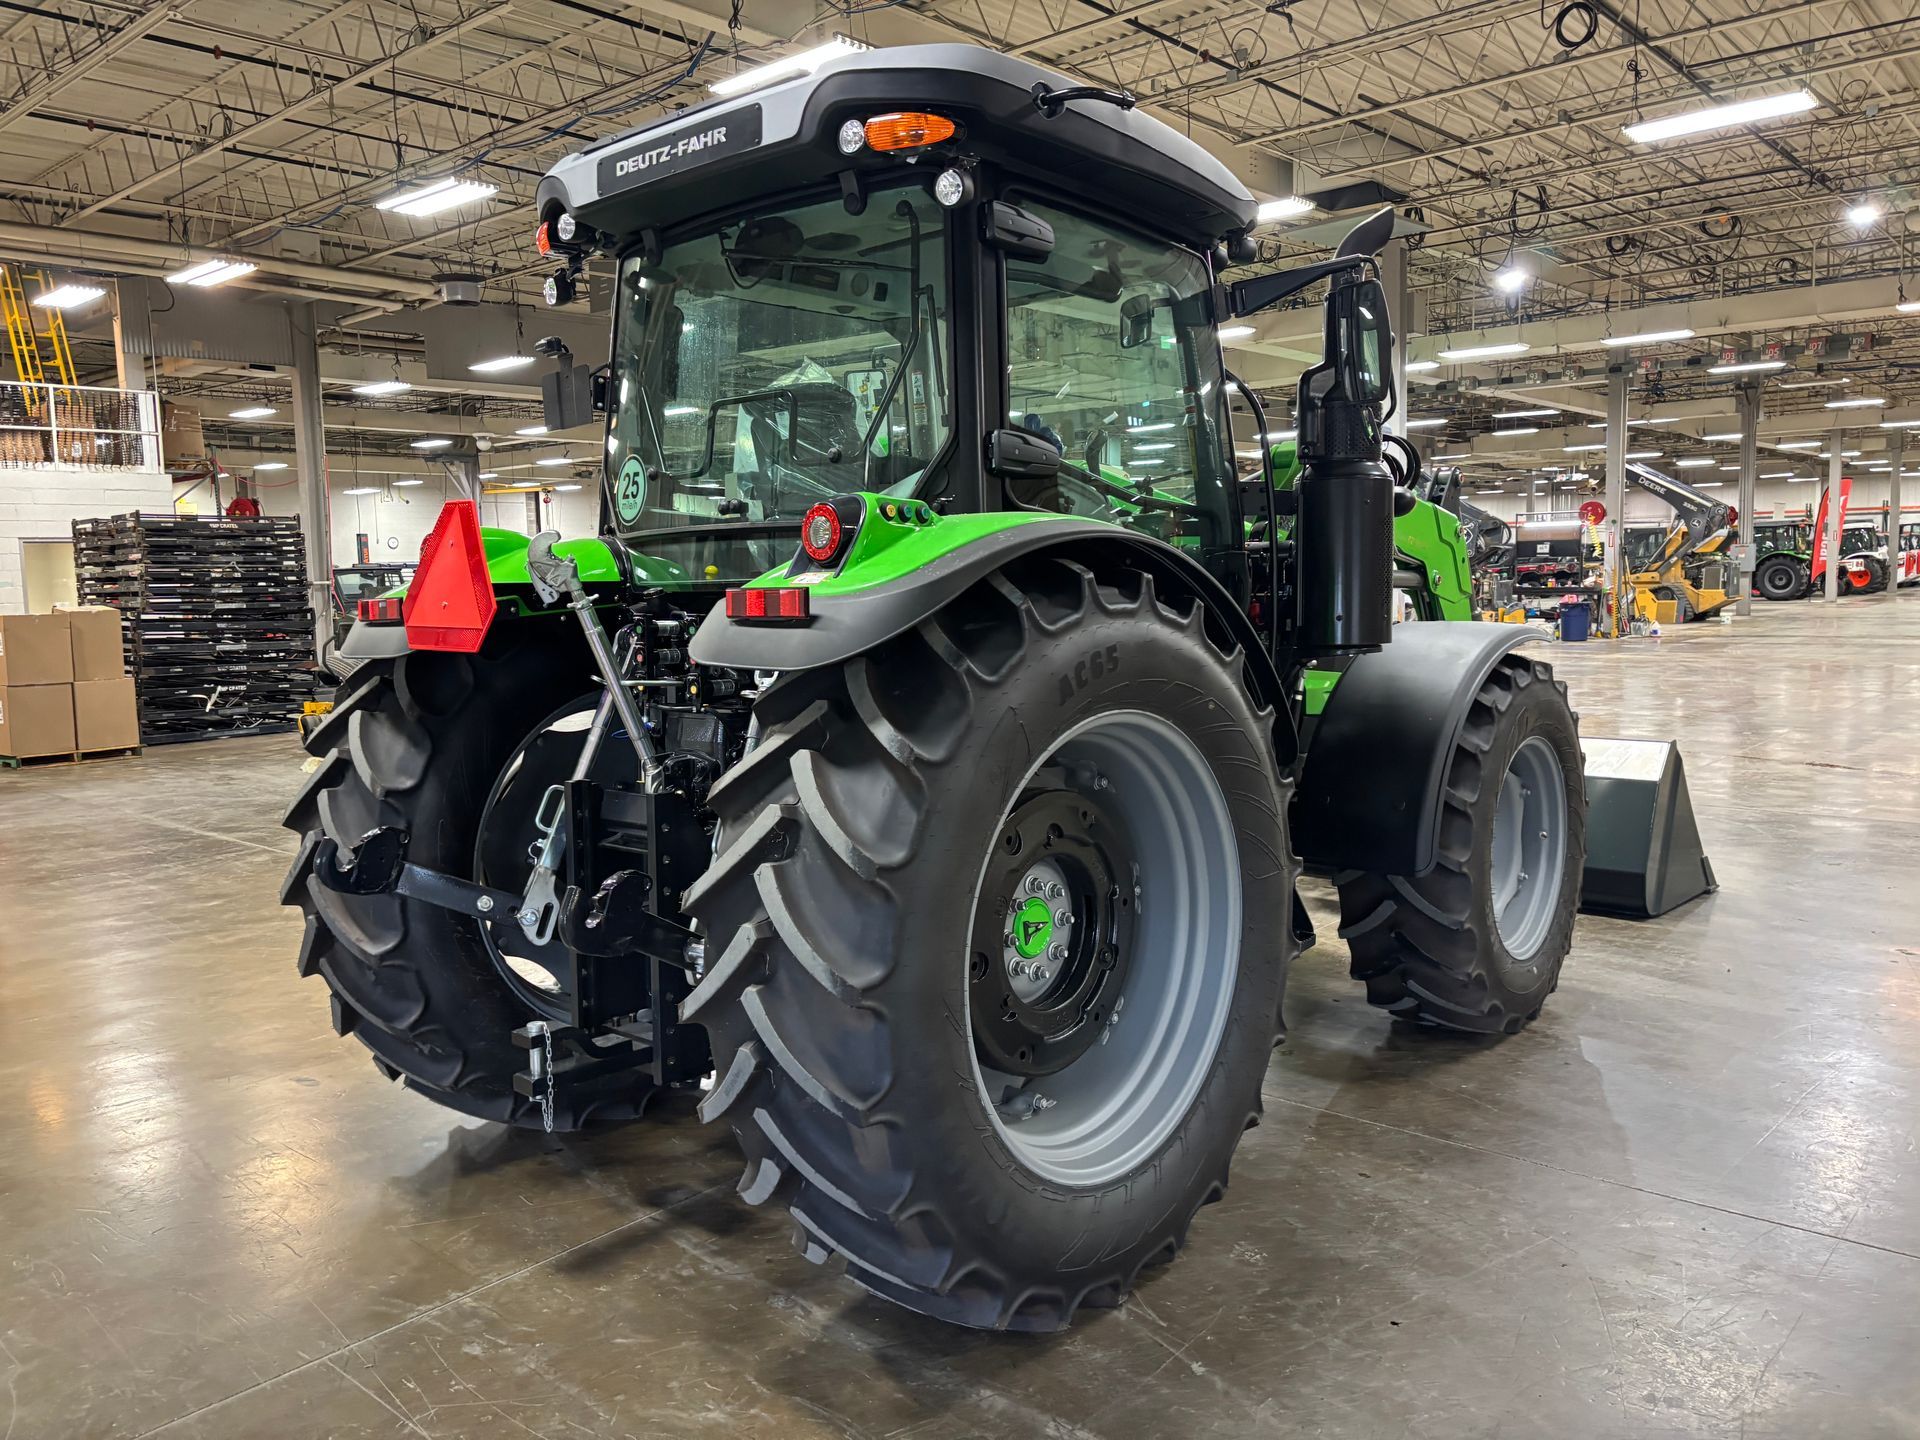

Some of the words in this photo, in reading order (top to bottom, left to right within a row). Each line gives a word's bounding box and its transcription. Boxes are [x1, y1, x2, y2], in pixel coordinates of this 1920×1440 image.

[615, 126, 727, 177] DEUTZ-FAHR
[1766, 348, 1780, 357] 105
[1808, 341, 1823, 351] 107
[1722, 352, 1735, 360] 103
[1565, 370, 1575, 378] 95
[622, 472, 640, 500] 25
[1638, 476, 1667, 495] DEERE
[1058, 643, 1119, 706] AC65
